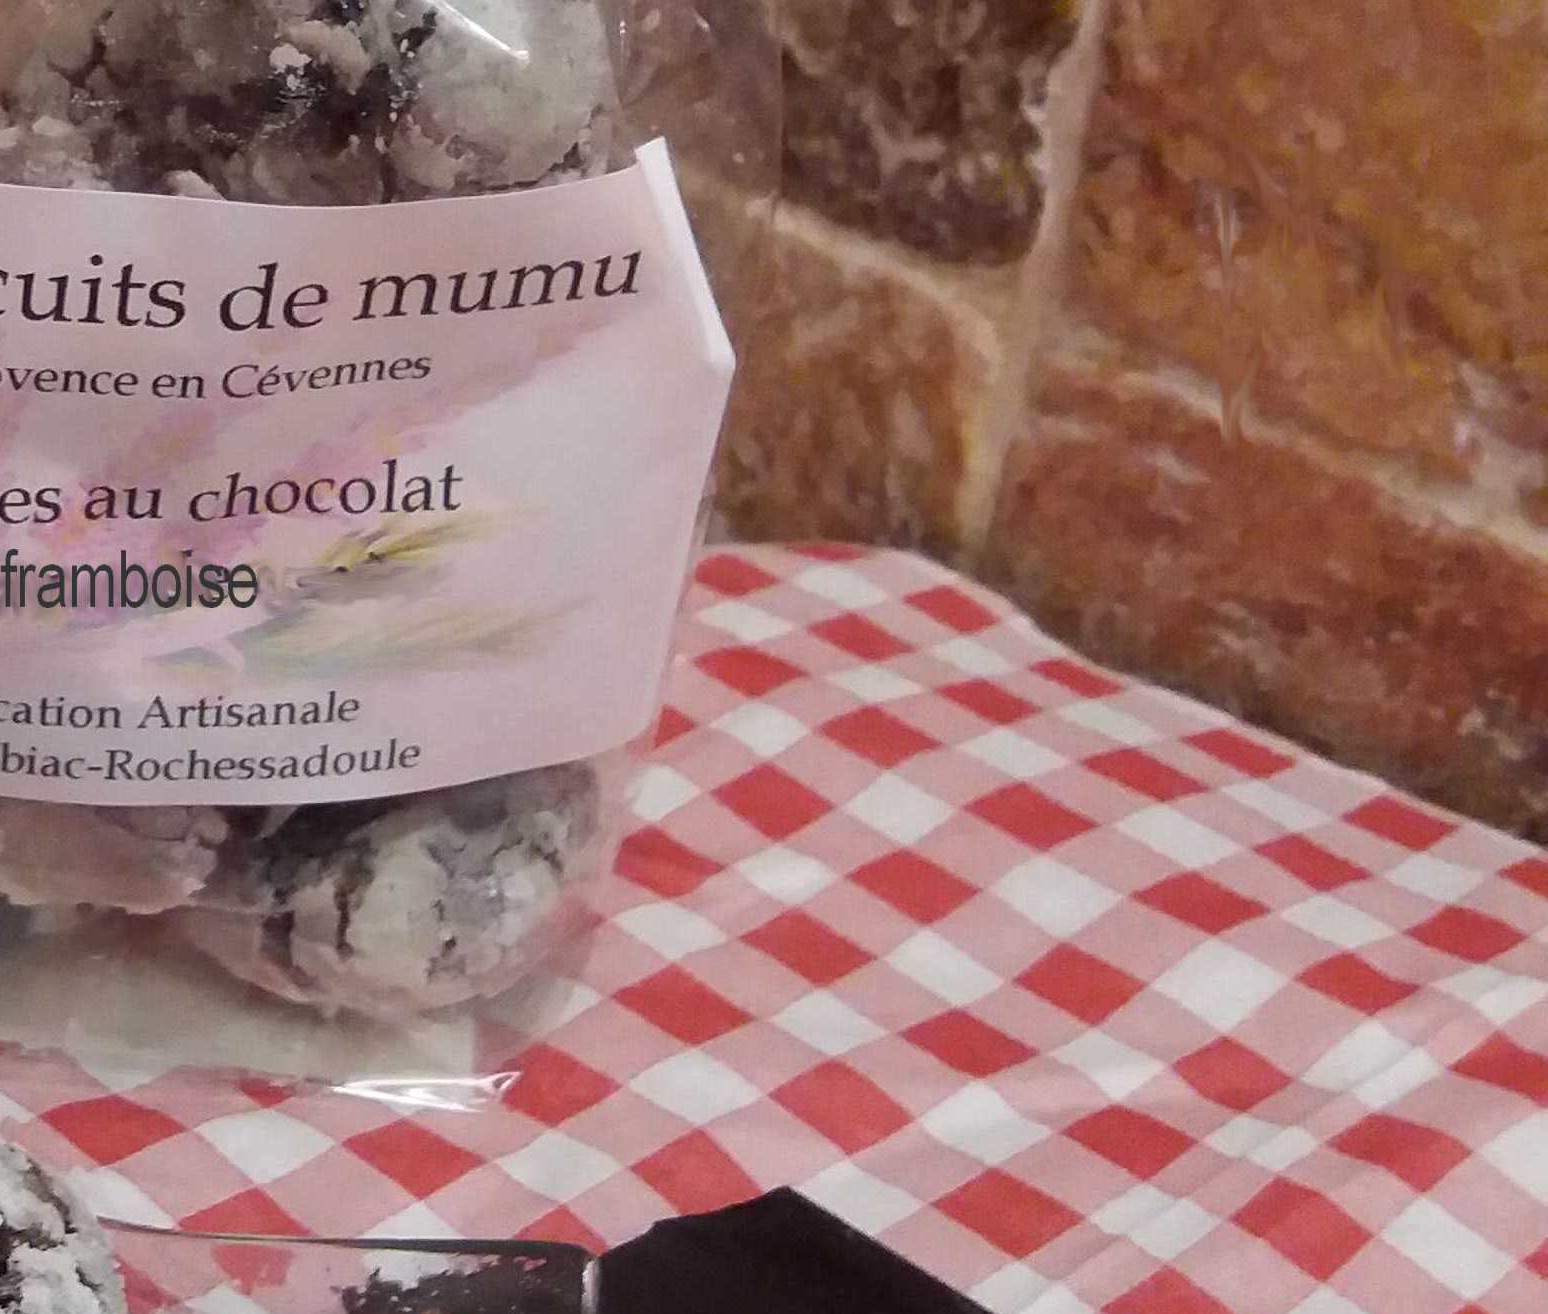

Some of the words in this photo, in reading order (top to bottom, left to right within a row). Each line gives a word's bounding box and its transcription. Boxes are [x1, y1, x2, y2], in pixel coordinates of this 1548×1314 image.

[219, 262, 330, 332] de
[352, 248, 643, 323] mumu
[152, 372, 208, 399] en
[221, 355, 433, 400] Cévennes
[82, 484, 164, 521] au
[188, 459, 465, 523] chocolat
[136, 690, 362, 732] Artisanale
